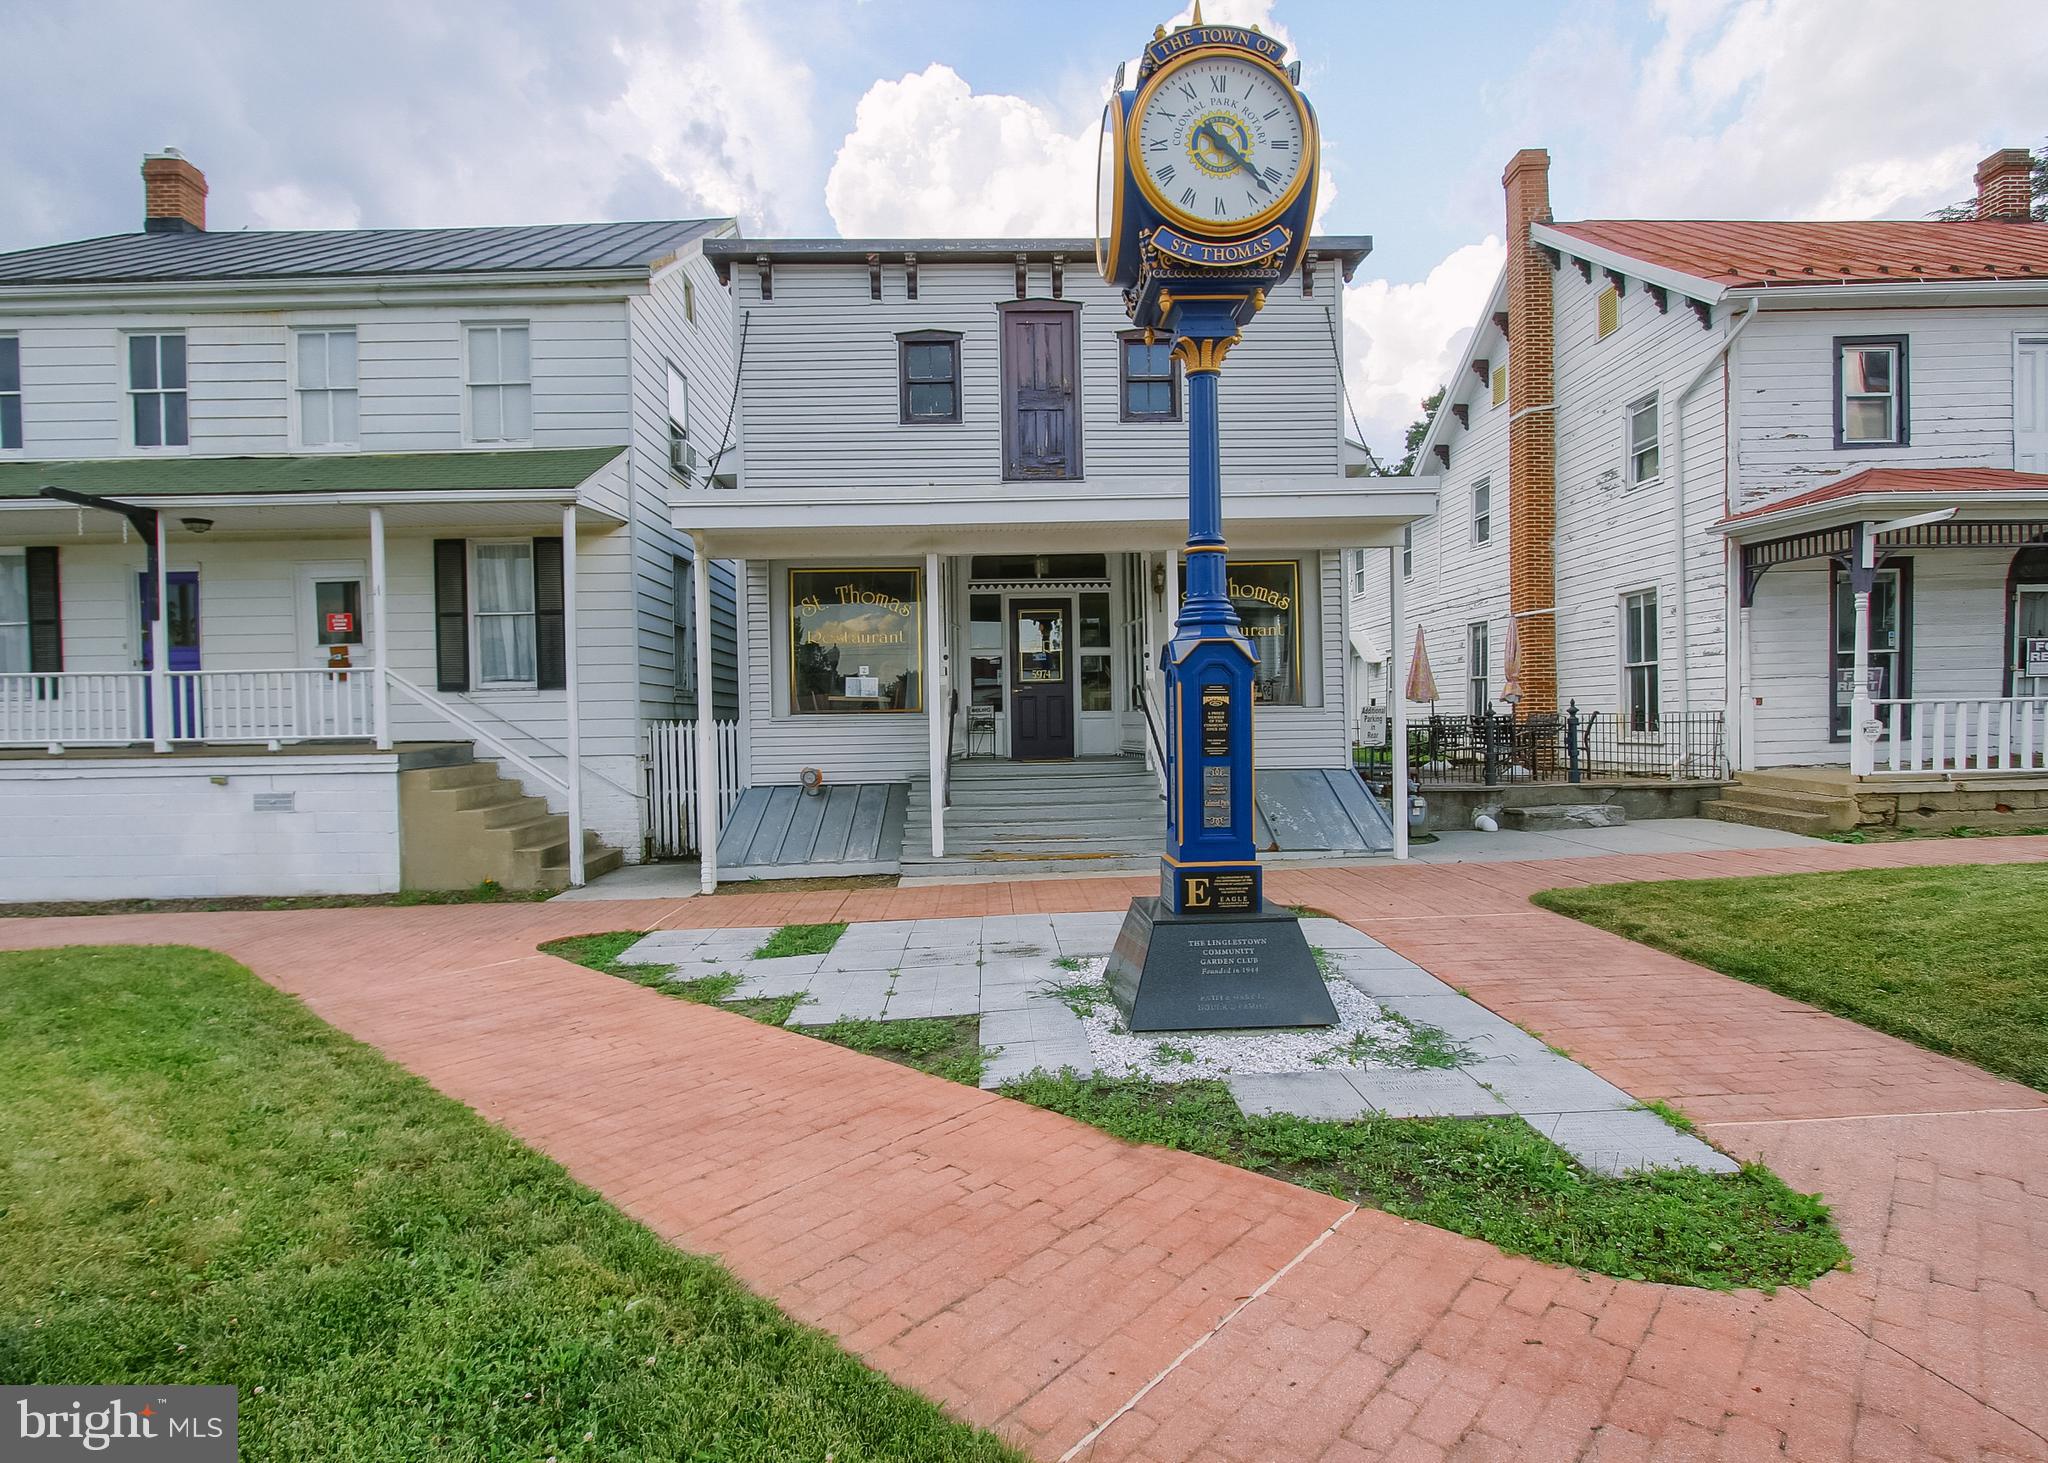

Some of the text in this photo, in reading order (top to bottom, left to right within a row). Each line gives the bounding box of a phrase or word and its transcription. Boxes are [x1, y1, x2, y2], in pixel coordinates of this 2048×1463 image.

[1158, 29, 1278, 57] THE TOWN OF
[1172, 97, 1268, 146] COLONIAL PARK ROTARY
[1170, 237, 1272, 261] ST. THOMAS
[1227, 577, 1290, 610] homas
[801, 584, 911, 617] St. Thomas
[808, 630, 904, 645] Restaurant
[1032, 669, 1051, 679] 5974
[1843, 671, 1875, 681] FR
[1838, 681, 1878, 691] RET
[1364, 715, 1383, 724] Parking
[1185, 878, 1211, 907] E
[1207, 938, 1267, 946] LINGLESTOWN
[1202, 948, 1255, 956] COMMUNITY
[1201, 967, 1231, 975] Founded
